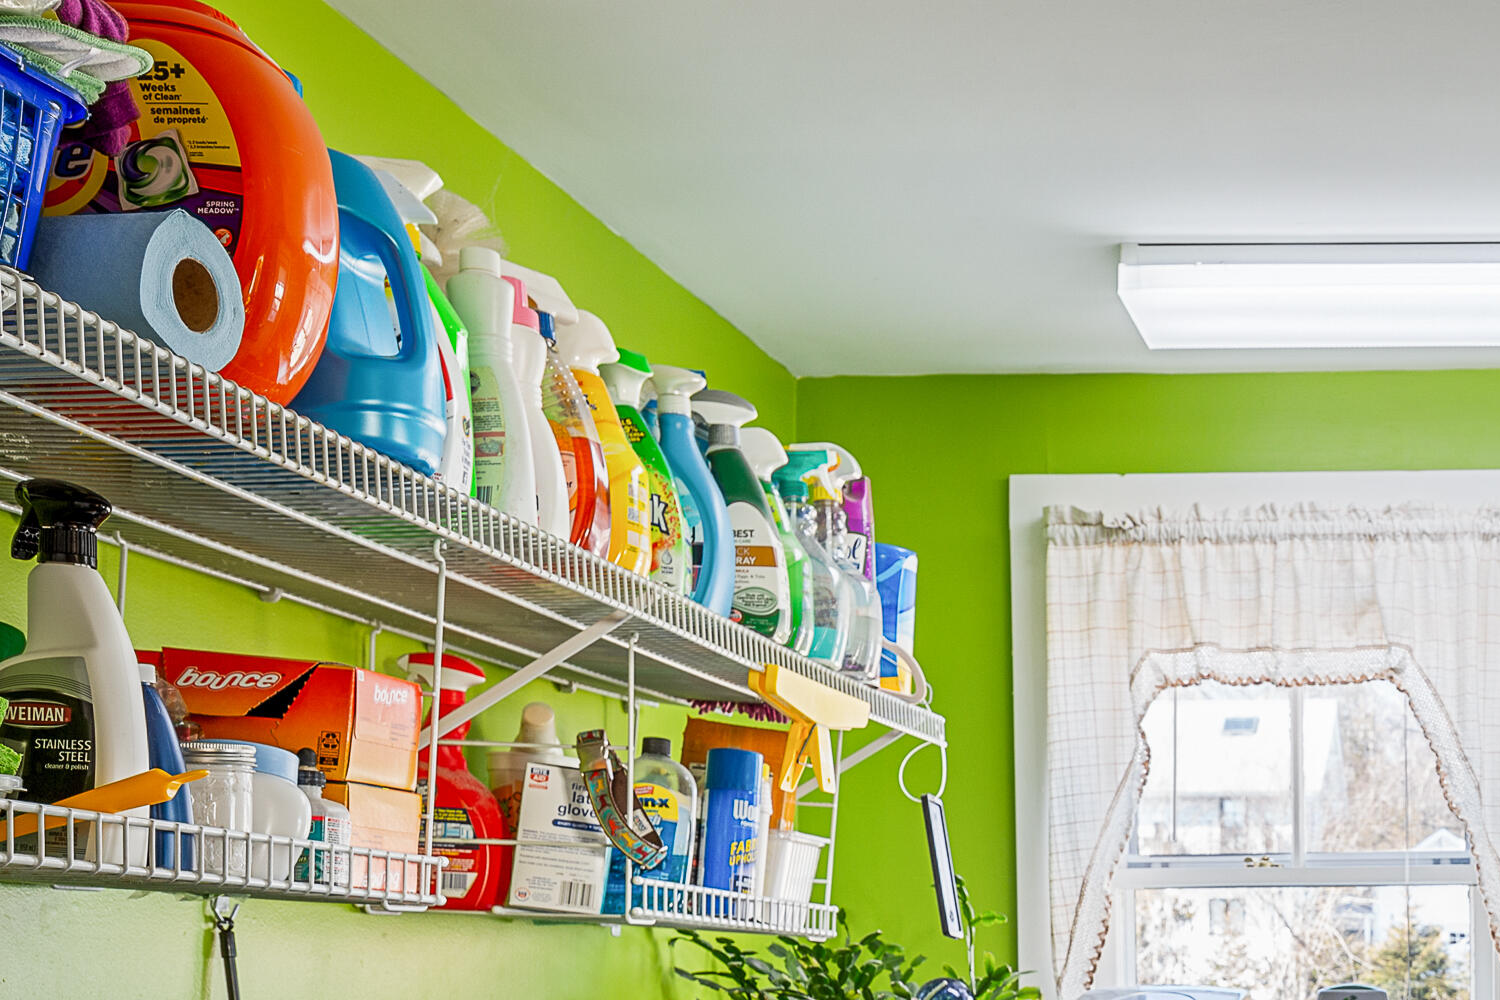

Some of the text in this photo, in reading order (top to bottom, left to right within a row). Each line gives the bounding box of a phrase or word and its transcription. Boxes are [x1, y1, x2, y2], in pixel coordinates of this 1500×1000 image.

[139, 83, 176, 92] Weeks
[150, 106, 201, 115] semaines
[736, 556, 756, 566] RAY
[175, 666, 282, 690] bounce
[374, 684, 409, 705] bounce
[5, 706, 65, 722] WEIMAN
[34, 738, 92, 751] STAINLESS
[58, 751, 91, 763] STEEL
[558, 803, 596, 817] glove
